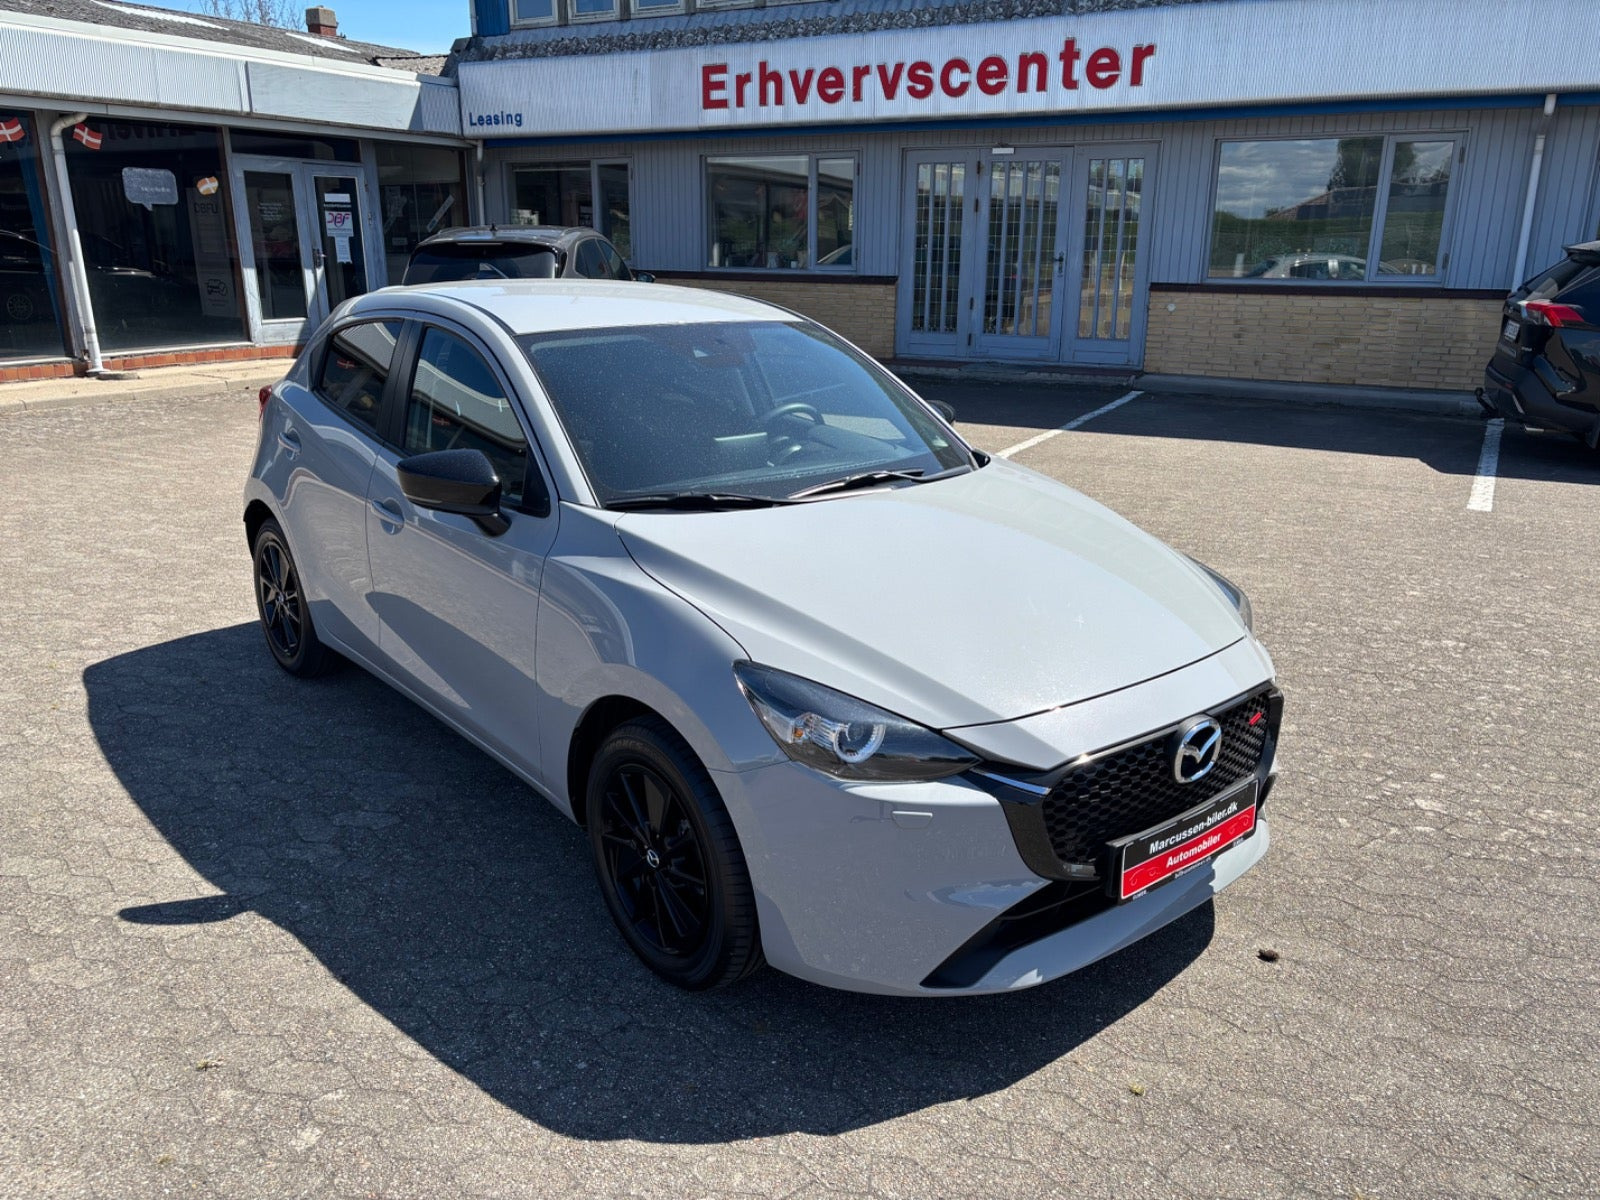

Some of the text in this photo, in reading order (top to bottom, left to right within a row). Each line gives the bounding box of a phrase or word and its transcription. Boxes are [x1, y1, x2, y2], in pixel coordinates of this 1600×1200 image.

[701, 37, 1155, 110] Erhvervscenter
[468, 110, 522, 127] Leasing
[1149, 802, 1238, 854] Marcussen-biler.dk
[1166, 832, 1222, 868] Automobiler
